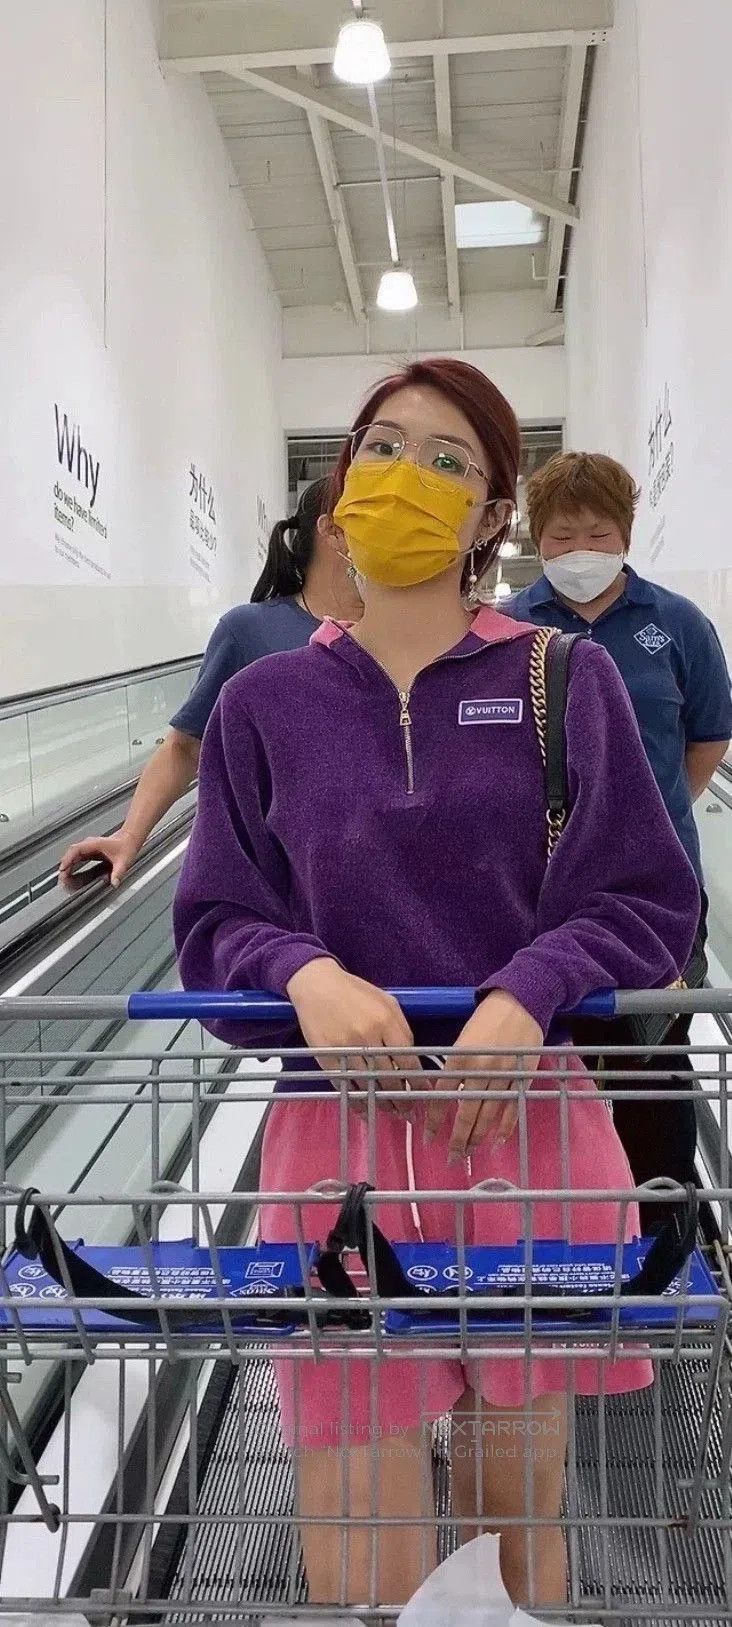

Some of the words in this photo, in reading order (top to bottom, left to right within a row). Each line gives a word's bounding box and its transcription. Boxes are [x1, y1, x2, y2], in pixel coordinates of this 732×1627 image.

[54, 403, 100, 508] Why
[54, 481, 63, 501] do
[74, 496, 87, 522] have
[188, 462, 216, 524] 为什么
[476, 706, 515, 714] VUITTON
